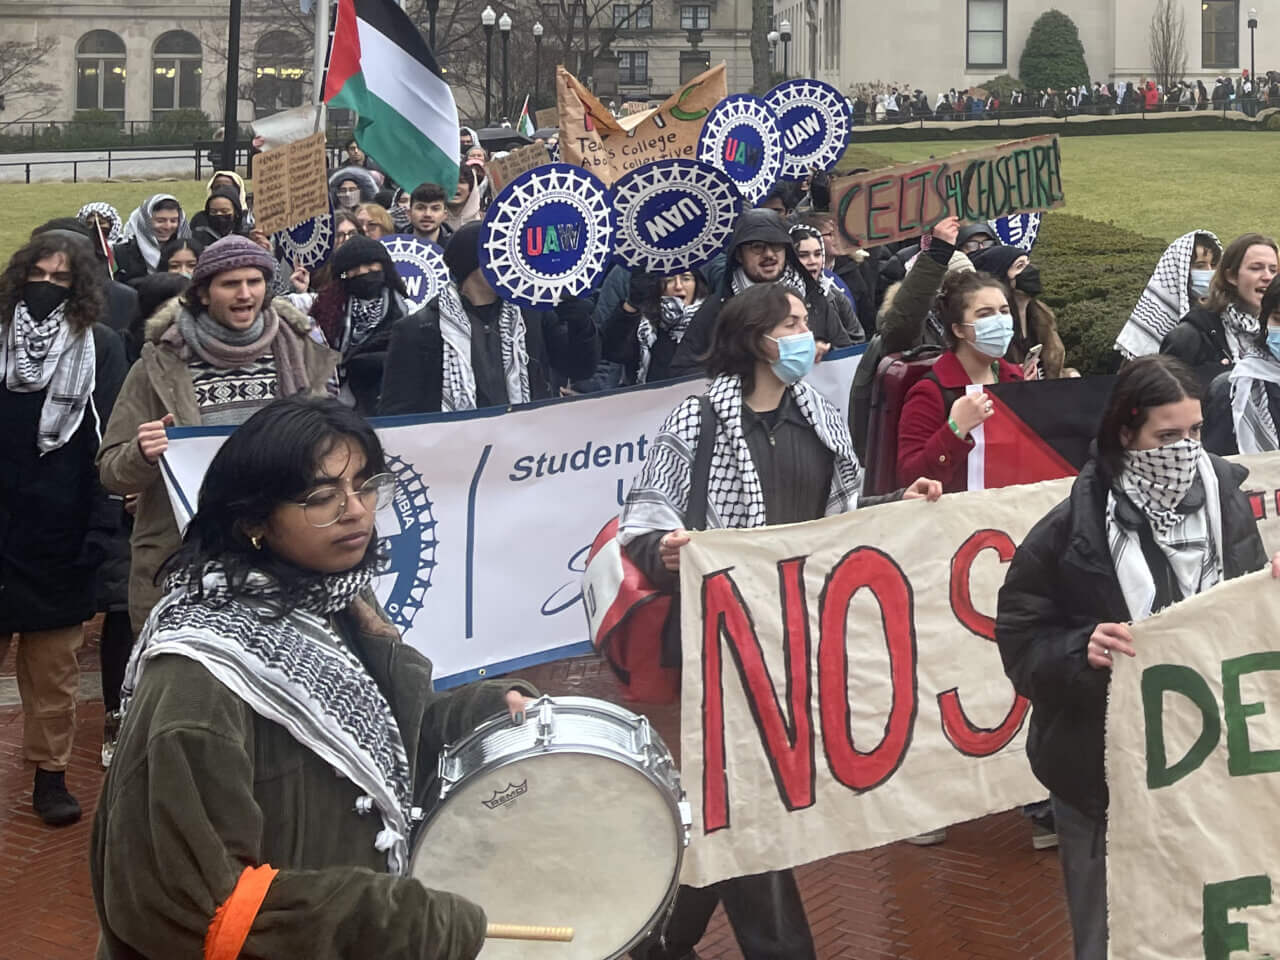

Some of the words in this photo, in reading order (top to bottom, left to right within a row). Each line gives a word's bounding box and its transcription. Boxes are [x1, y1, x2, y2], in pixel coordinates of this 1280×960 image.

[622, 132, 677, 156] College
[784, 112, 820, 150] UAW
[645, 197, 702, 243] UAW
[838, 162, 950, 246] CELTS
[527, 222, 580, 256] UAW
[1008, 213, 1022, 242] UA
[509, 434, 649, 482] Student
[702, 545, 917, 835] NO
